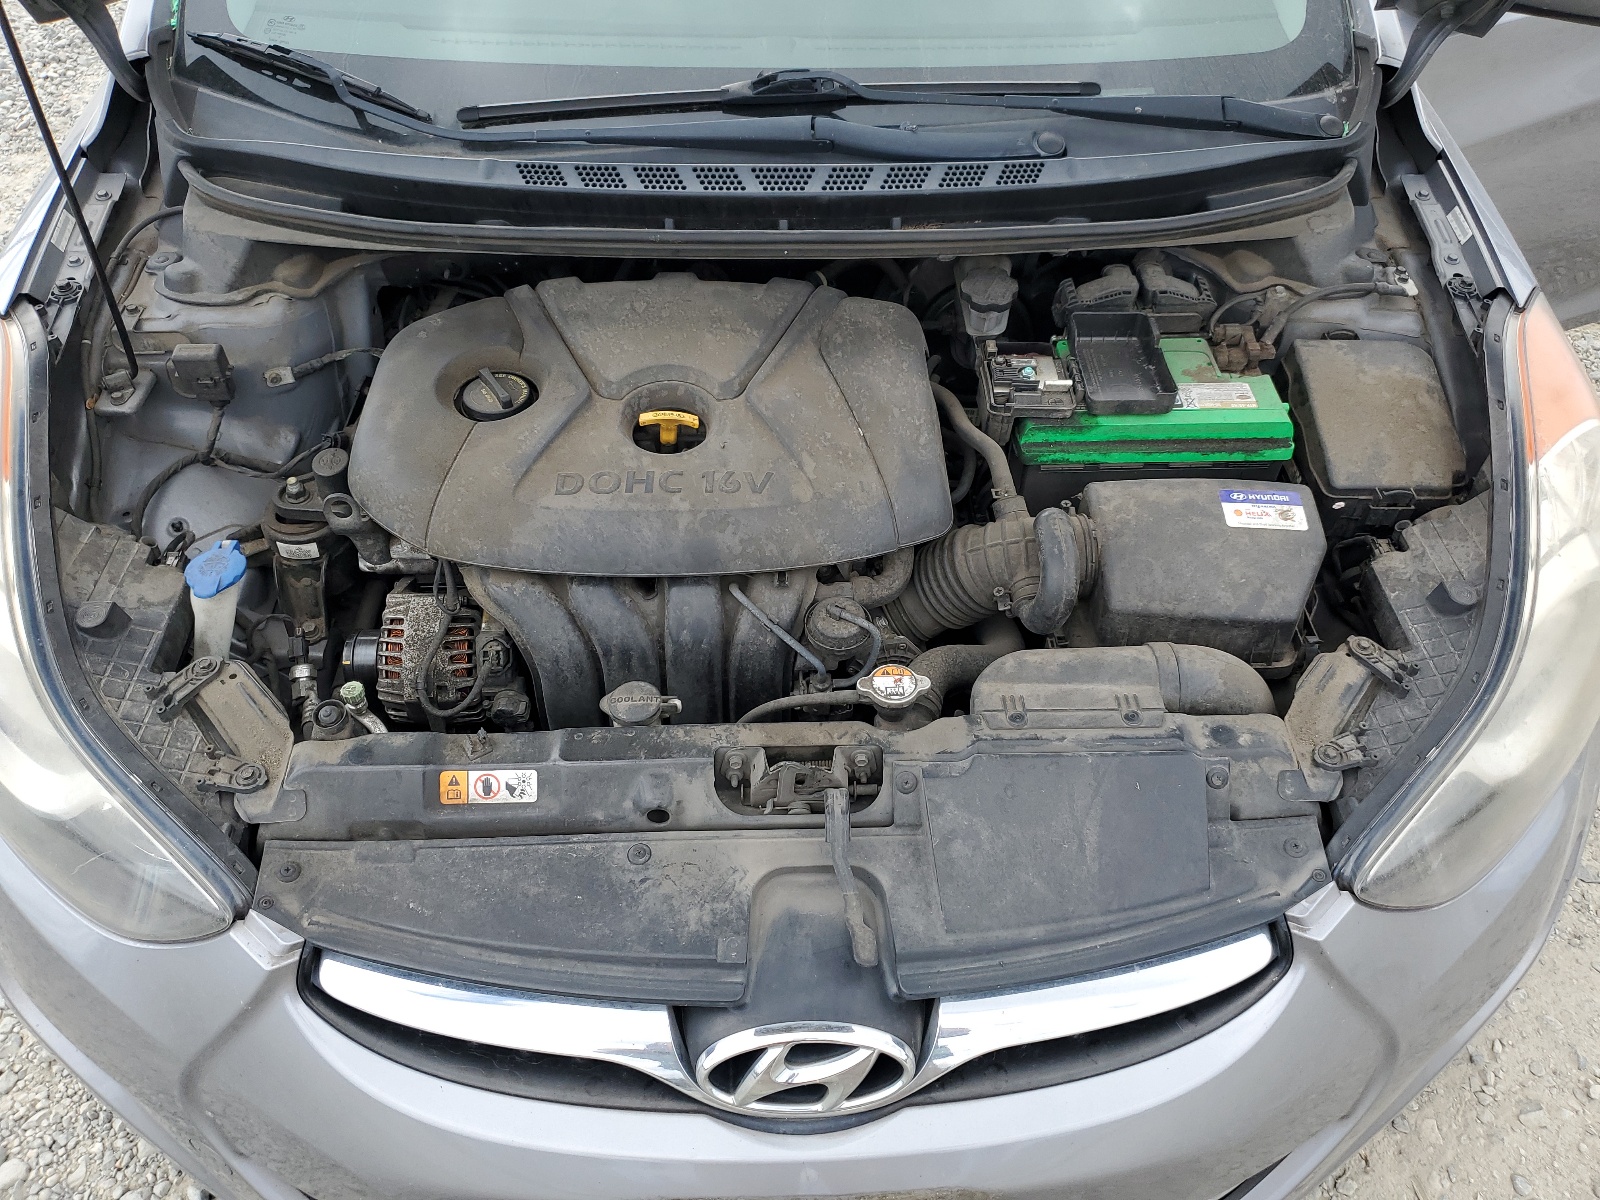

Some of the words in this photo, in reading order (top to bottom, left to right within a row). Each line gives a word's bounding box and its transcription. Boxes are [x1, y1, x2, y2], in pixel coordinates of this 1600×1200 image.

[554, 470, 684, 496] DOHC
[701, 470, 775, 495] 16V
[1248, 493, 1290, 502] HYUNDAI
[610, 695, 660, 704] COOLANT
